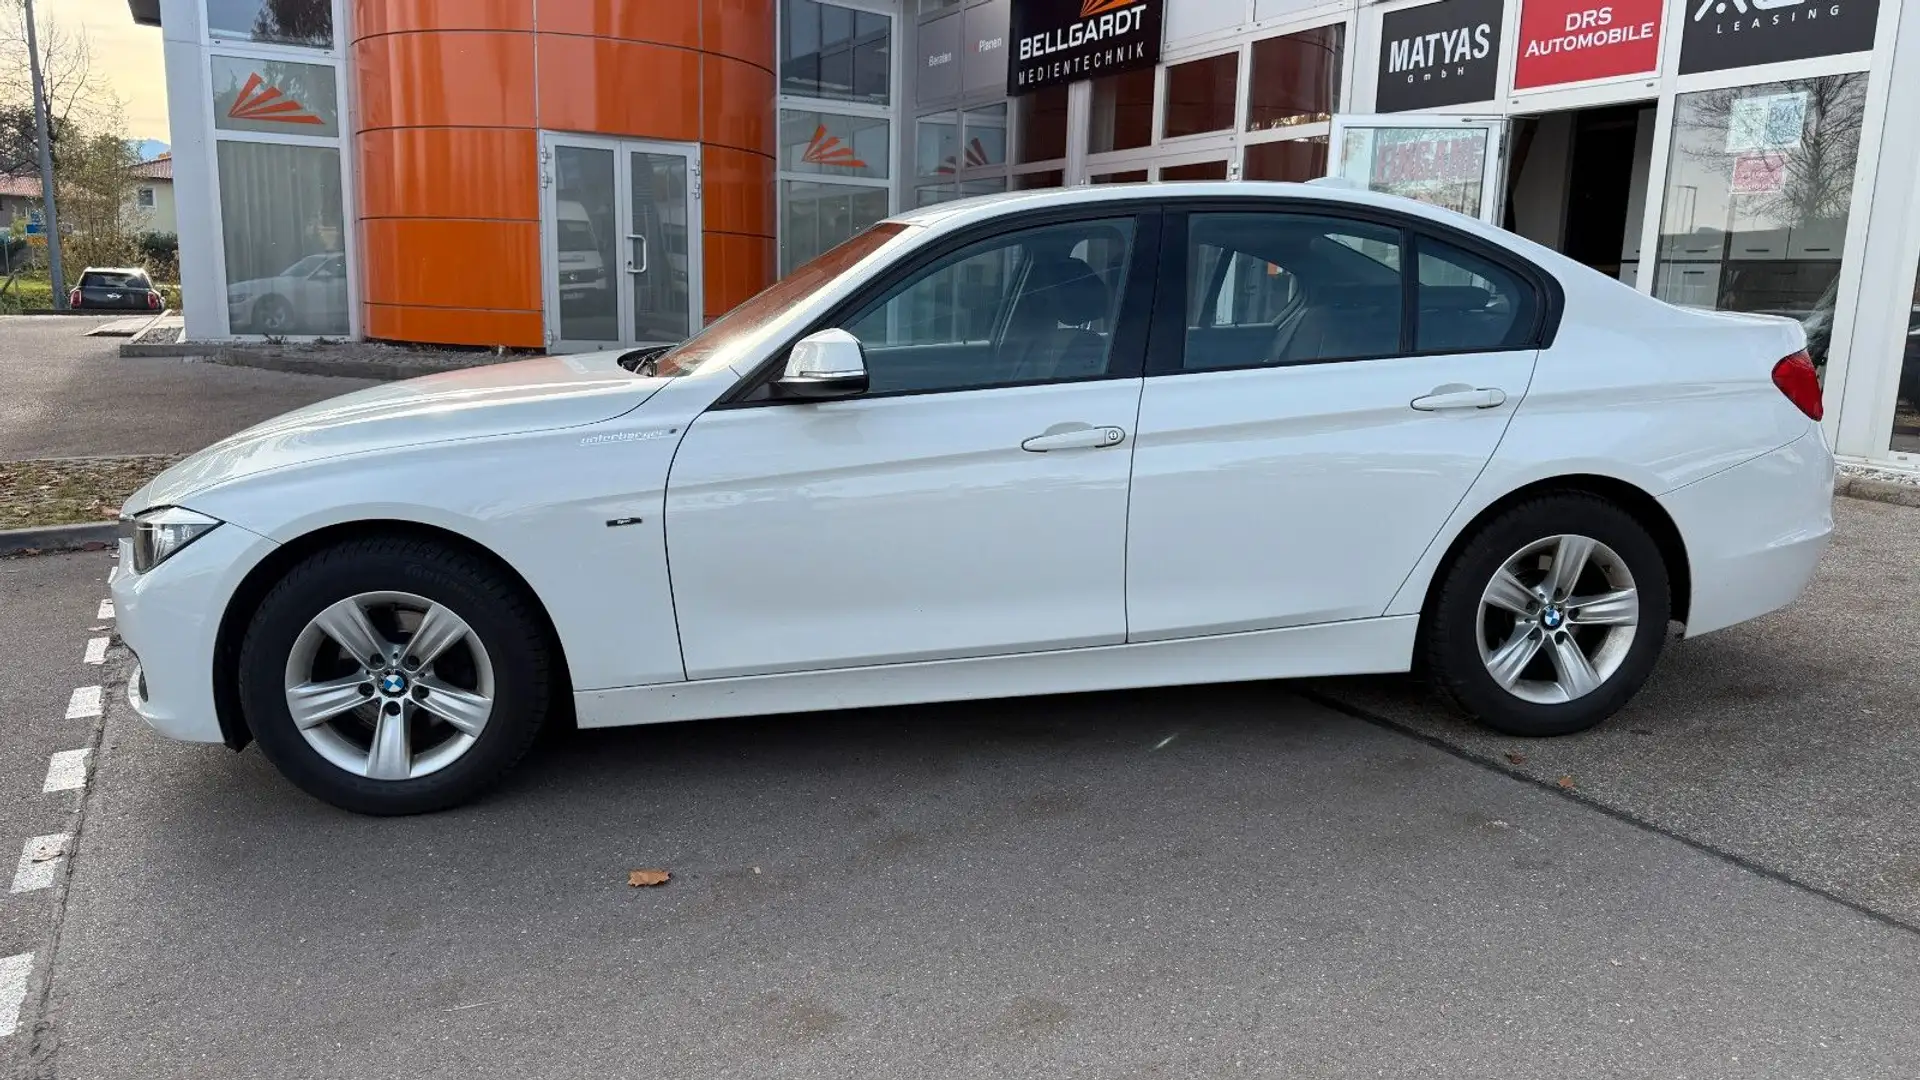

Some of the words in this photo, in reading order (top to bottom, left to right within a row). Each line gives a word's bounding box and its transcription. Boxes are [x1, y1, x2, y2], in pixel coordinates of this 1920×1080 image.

[1019, 4, 1147, 61] BELLGARDT
[1565, 6, 1613, 32] DRS
[1716, 4, 1840, 35] LEASING
[979, 37, 1002, 53] Planen
[1388, 23, 1491, 74] MATYAS
[928, 52, 952, 67] Beraten
[1018, 41, 1145, 86] MEDIENTECHNIK
[1407, 66, 1465, 83] GmbH
